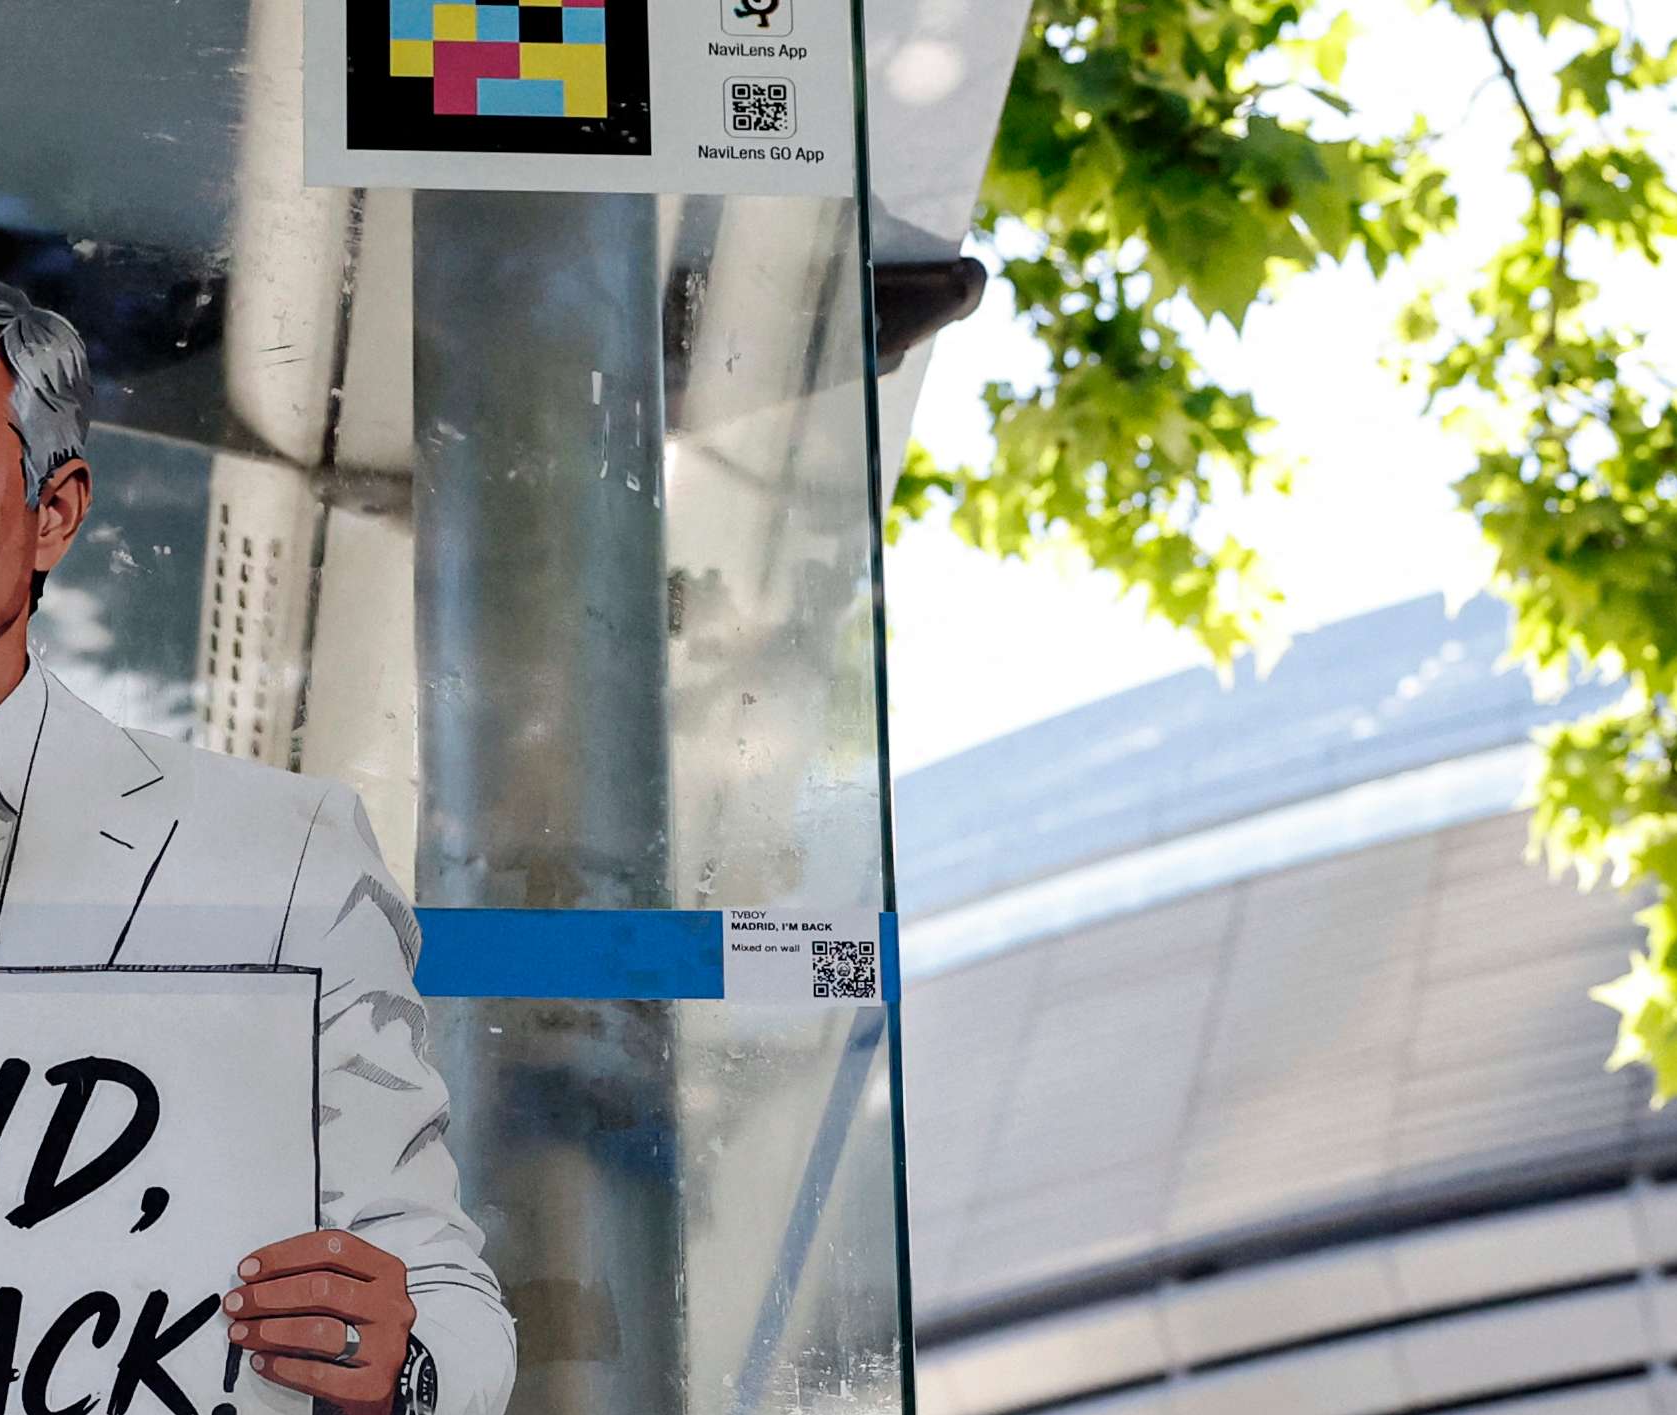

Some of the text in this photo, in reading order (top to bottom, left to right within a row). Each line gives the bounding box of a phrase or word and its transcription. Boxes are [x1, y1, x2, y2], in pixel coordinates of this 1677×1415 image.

[708, 42, 808, 61] NaviLens App
[698, 145, 825, 164] NaviLens GO App
[730, 910, 767, 920] TVBOY
[730, 921, 833, 932] MADRID, I'M BACK
[731, 943, 801, 953] Mixed on wall
